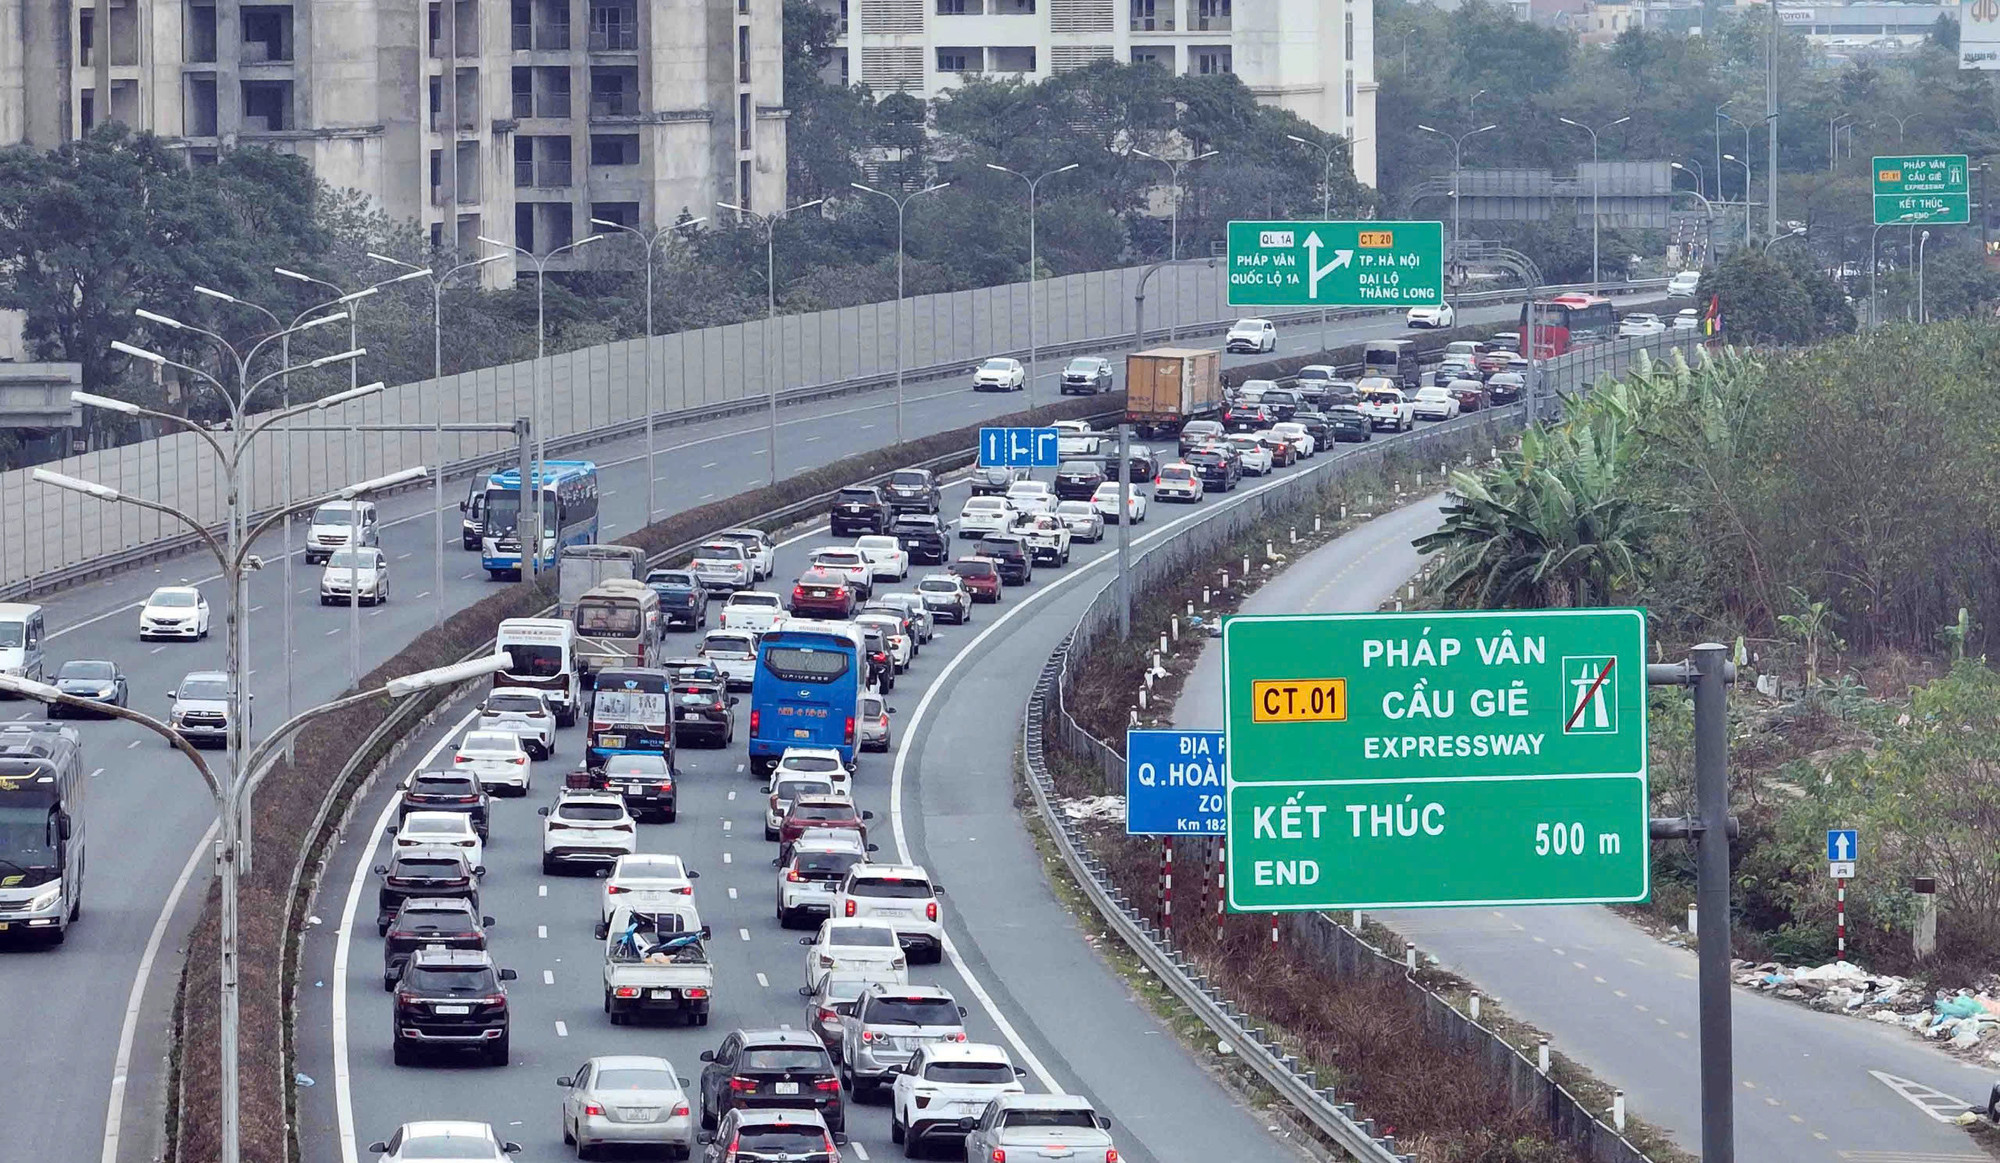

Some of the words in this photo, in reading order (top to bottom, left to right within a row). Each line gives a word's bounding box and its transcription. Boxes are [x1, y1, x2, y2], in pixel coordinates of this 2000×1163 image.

[1903, 160, 1926, 169] PHÁP
[1929, 160, 1946, 169] VÂN
[1899, 197, 1916, 209] KẾT
[1919, 197, 1943, 208] THÚC
[1237, 253, 1268, 266] PHÁP
[1273, 253, 1295, 266] VÂN
[1400, 254, 1420, 269] NỘI
[1231, 269, 1263, 285] QUỐC
[1267, 271, 1282, 287] LỘ
[1286, 274, 1300, 284] 1A
[1359, 273, 1379, 285] ĐẠI
[1384, 272, 1399, 287] LỘ
[1359, 286, 1399, 299] THĂNG
[1403, 288, 1435, 299] LONG
[1363, 626, 1461, 668] PHÁP
[1475, 628, 1545, 666] VÂN
[1263, 686, 1336, 716] CT.01
[1382, 677, 1455, 720] CẦU
[1470, 680, 1529, 717] GIẼ
[1179, 737, 1210, 760] ĐỊA
[1364, 733, 1545, 759] EXPRESSWAY
[1198, 794, 1226, 813] ZO
[1253, 790, 1327, 839] KẾT
[1345, 793, 1445, 837] THÚC
[1177, 818, 1200, 831] Km
[1535, 822, 1585, 856] 500
[1599, 832, 1620, 855] m
[1254, 860, 1320, 886] END
